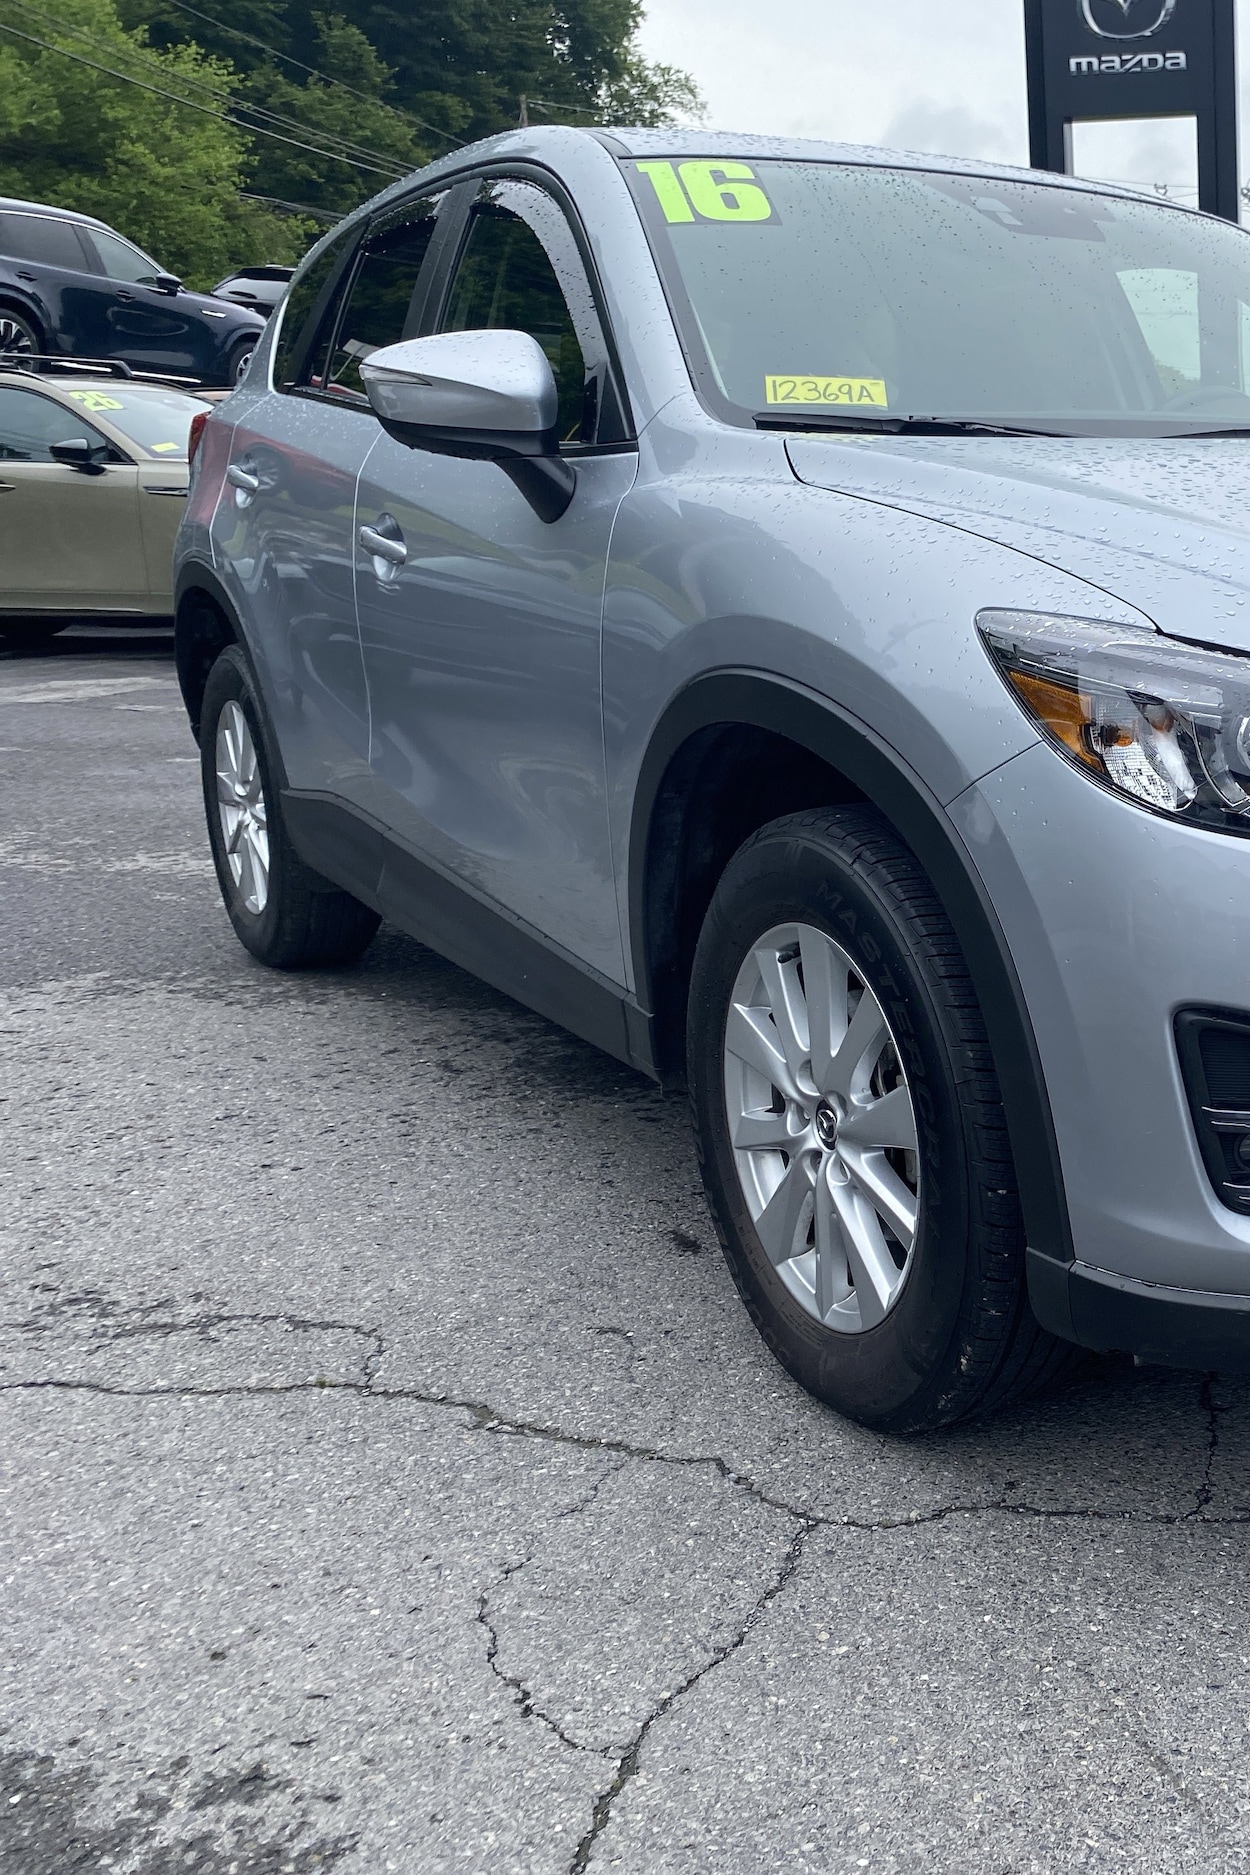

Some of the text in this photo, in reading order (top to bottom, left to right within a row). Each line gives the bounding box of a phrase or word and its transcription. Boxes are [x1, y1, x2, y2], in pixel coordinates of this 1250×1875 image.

[1069, 51, 1187, 74] mazda
[635, 161, 772, 223] 16
[771, 379, 875, 402] 12369A
[815, 882, 942, 1240] MASTERCRA
